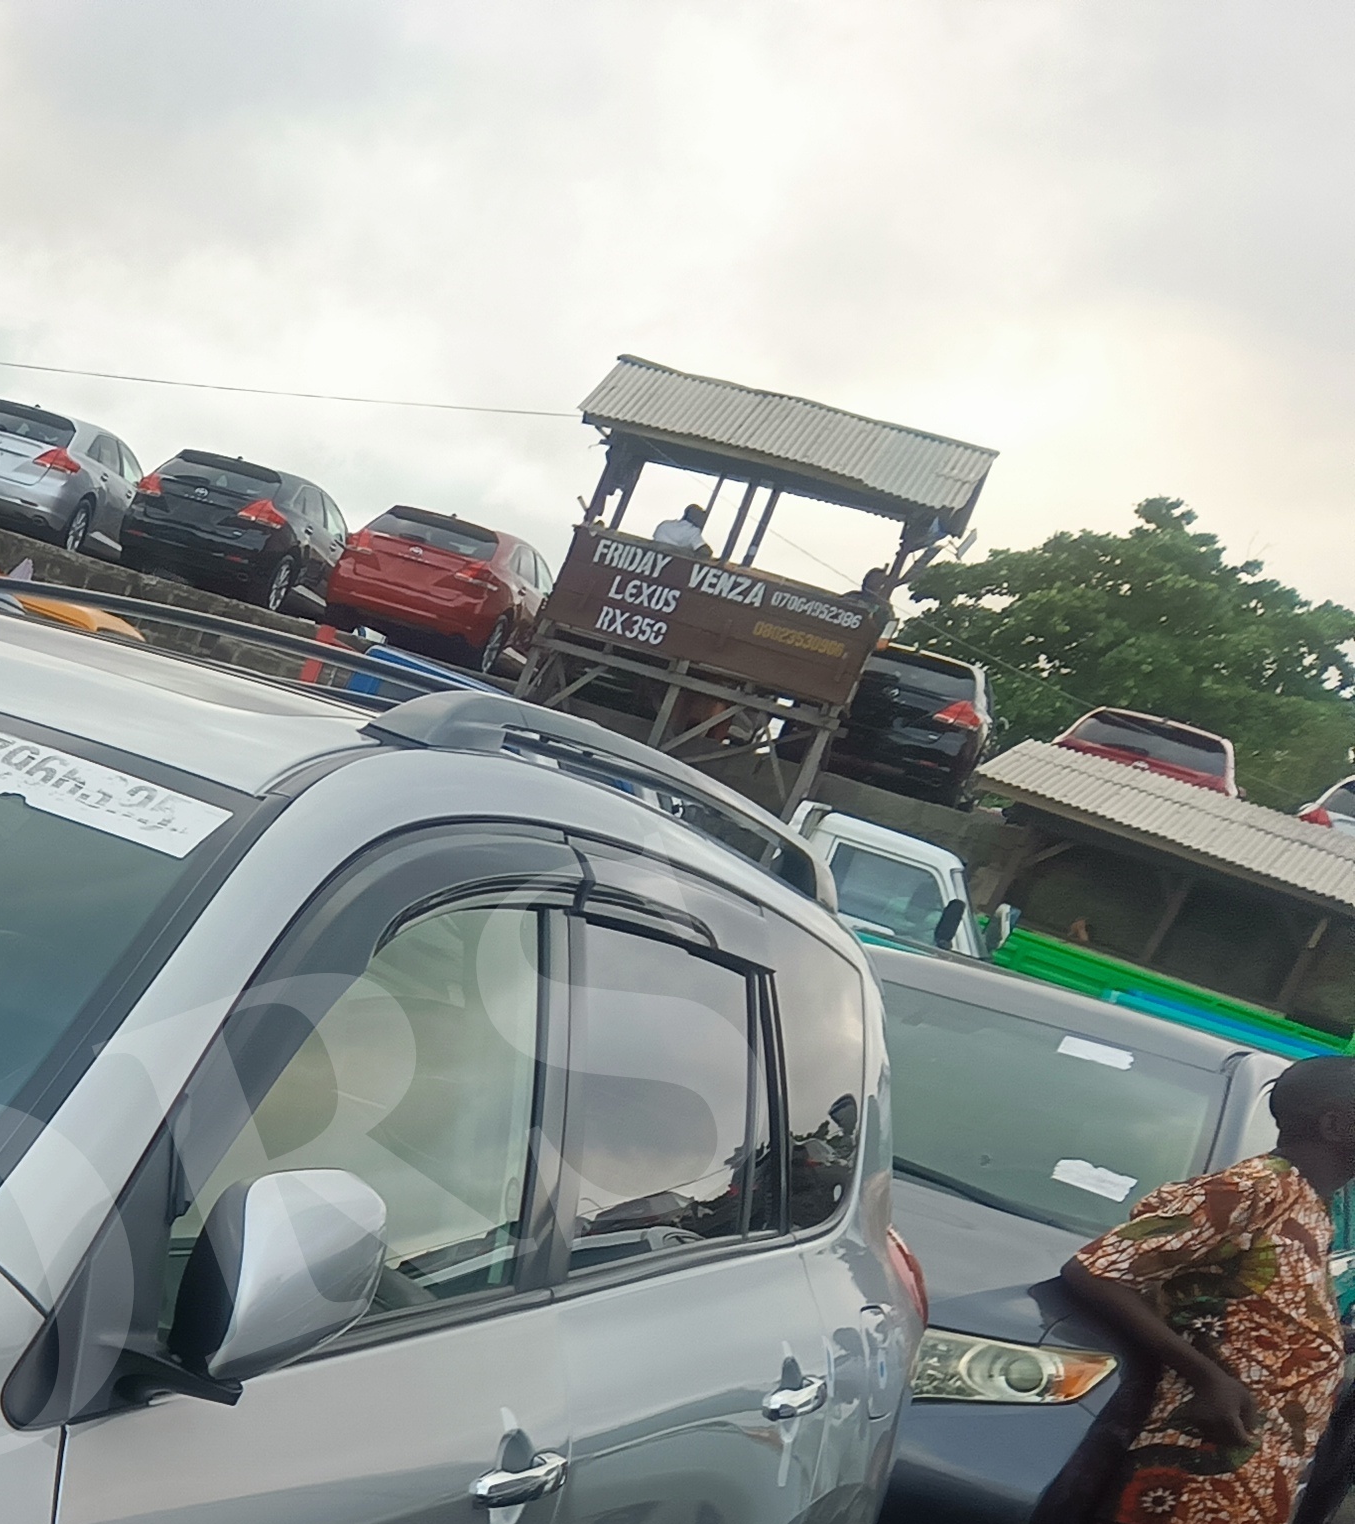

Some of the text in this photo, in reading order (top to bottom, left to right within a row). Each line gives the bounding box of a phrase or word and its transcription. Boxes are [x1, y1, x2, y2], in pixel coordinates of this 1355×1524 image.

[593, 539, 673, 578] FRIDAY
[688, 564, 766, 607] VENZA
[608, 575, 681, 613] LEXUS
